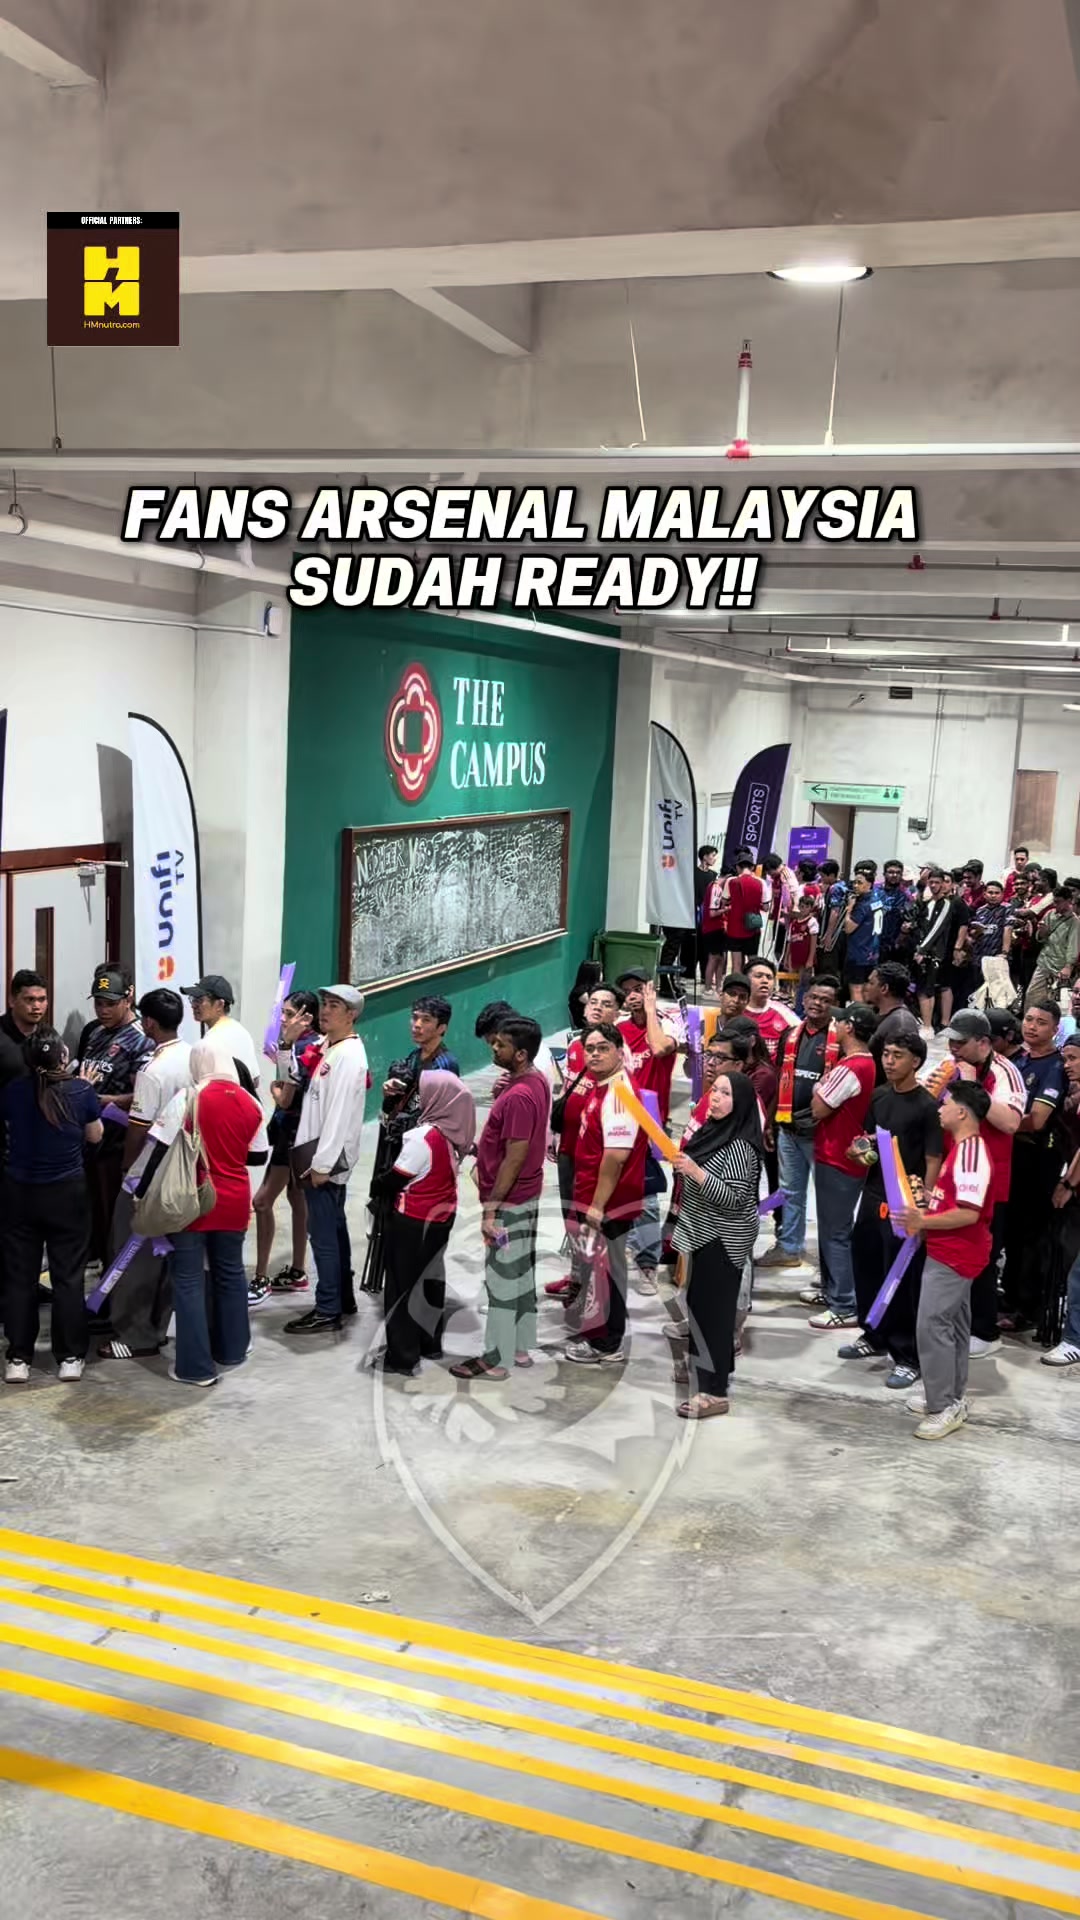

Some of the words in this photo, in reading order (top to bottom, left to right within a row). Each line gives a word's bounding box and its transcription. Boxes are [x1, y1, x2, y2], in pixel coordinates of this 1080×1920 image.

[453, 676, 505, 727] THE
[450, 739, 546, 790] CAMPUS
[658, 797, 675, 850] unifi
[674, 799, 684, 821] TV
[745, 787, 766, 842] SPORTS
[175, 849, 184, 886] TV
[150, 850, 174, 948] unifi
